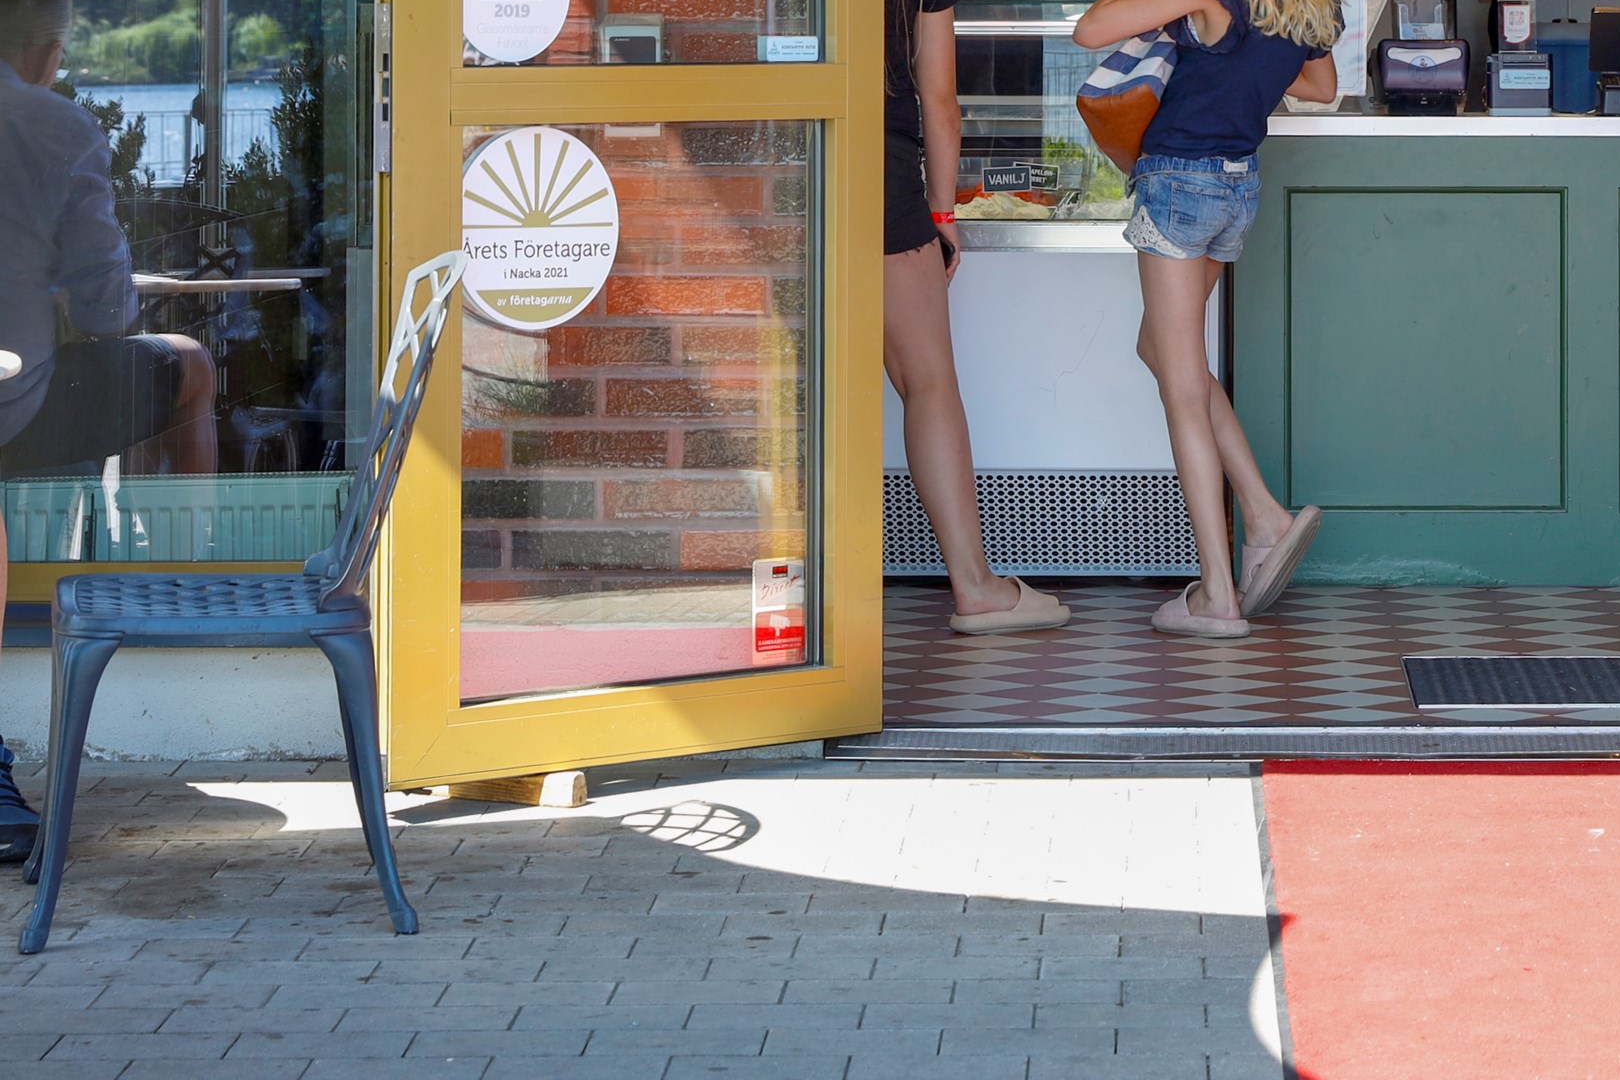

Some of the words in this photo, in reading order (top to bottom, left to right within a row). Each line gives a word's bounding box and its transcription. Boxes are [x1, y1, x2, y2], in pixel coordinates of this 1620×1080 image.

[494, 4, 531, 18] 2019
[988, 172, 1026, 185] VANILJ
[462, 237, 508, 260] Årets
[514, 239, 611, 262] Företagare
[510, 268, 541, 279] Nacka
[544, 267, 569, 278] 2021
